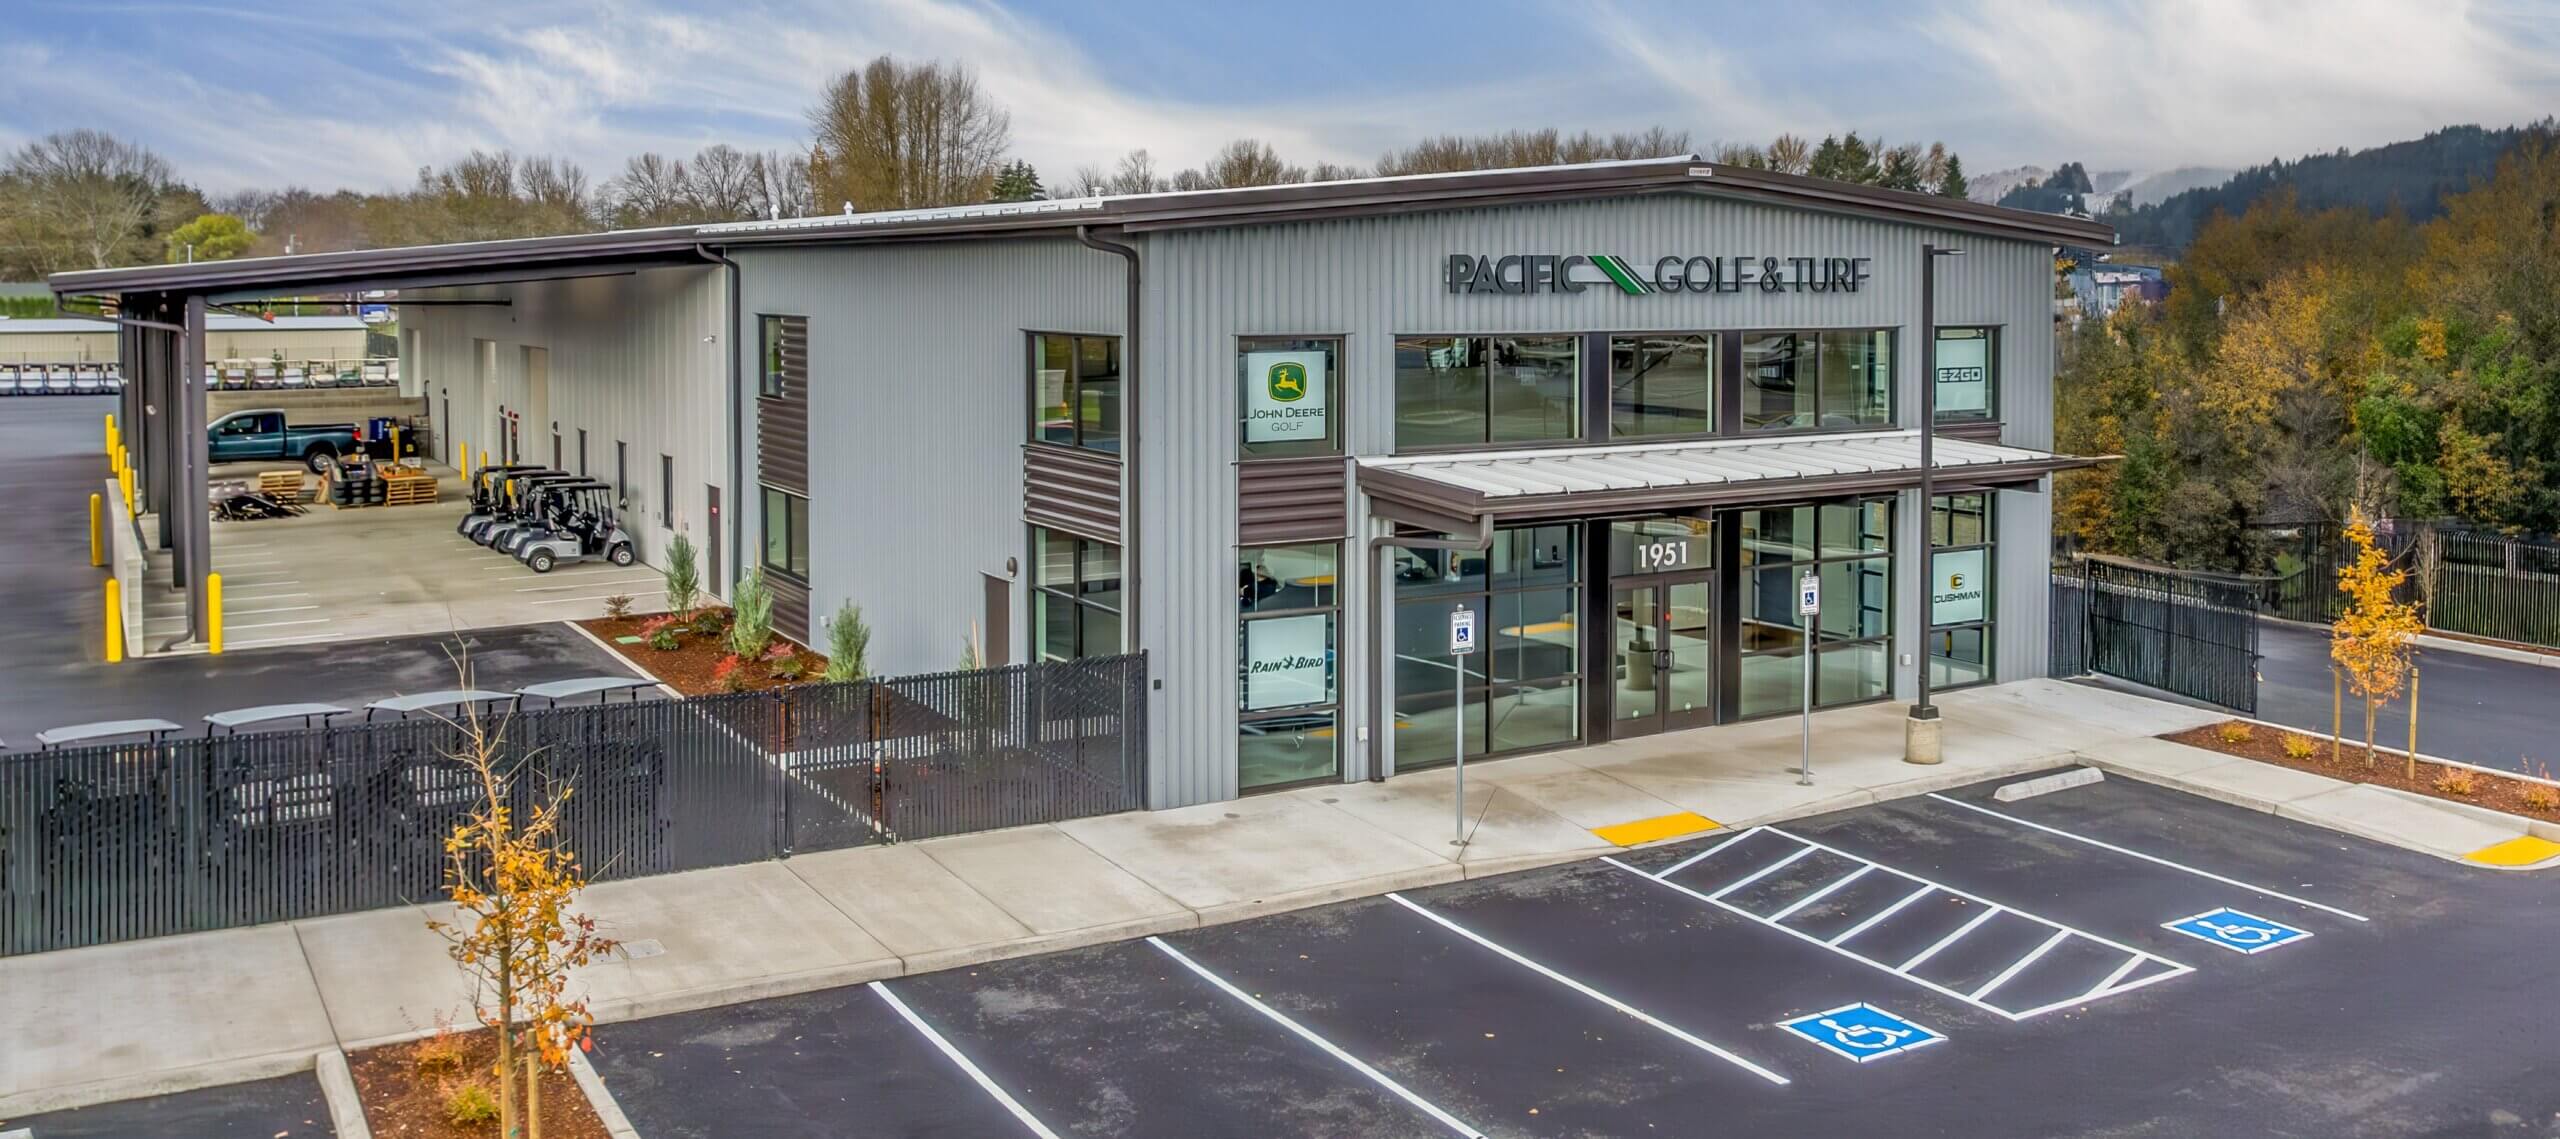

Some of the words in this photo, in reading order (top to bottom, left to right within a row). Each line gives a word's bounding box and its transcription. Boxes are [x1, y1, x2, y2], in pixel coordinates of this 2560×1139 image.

[1448, 254, 1588, 294] PACIFIC
[1654, 256, 1756, 294] GOLF
[1759, 257, 1787, 294] &
[1787, 256, 1872, 294] TURF
[1249, 408, 1283, 420] JOHN
[1285, 407, 1325, 418] DEERE
[1271, 421, 1304, 432] GOLF
[1639, 541, 1687, 568] 1951
[1934, 590, 1981, 604] CUSHMAN
[1250, 660, 1282, 674] RAIN
[1294, 656, 1324, 670] BIRD
